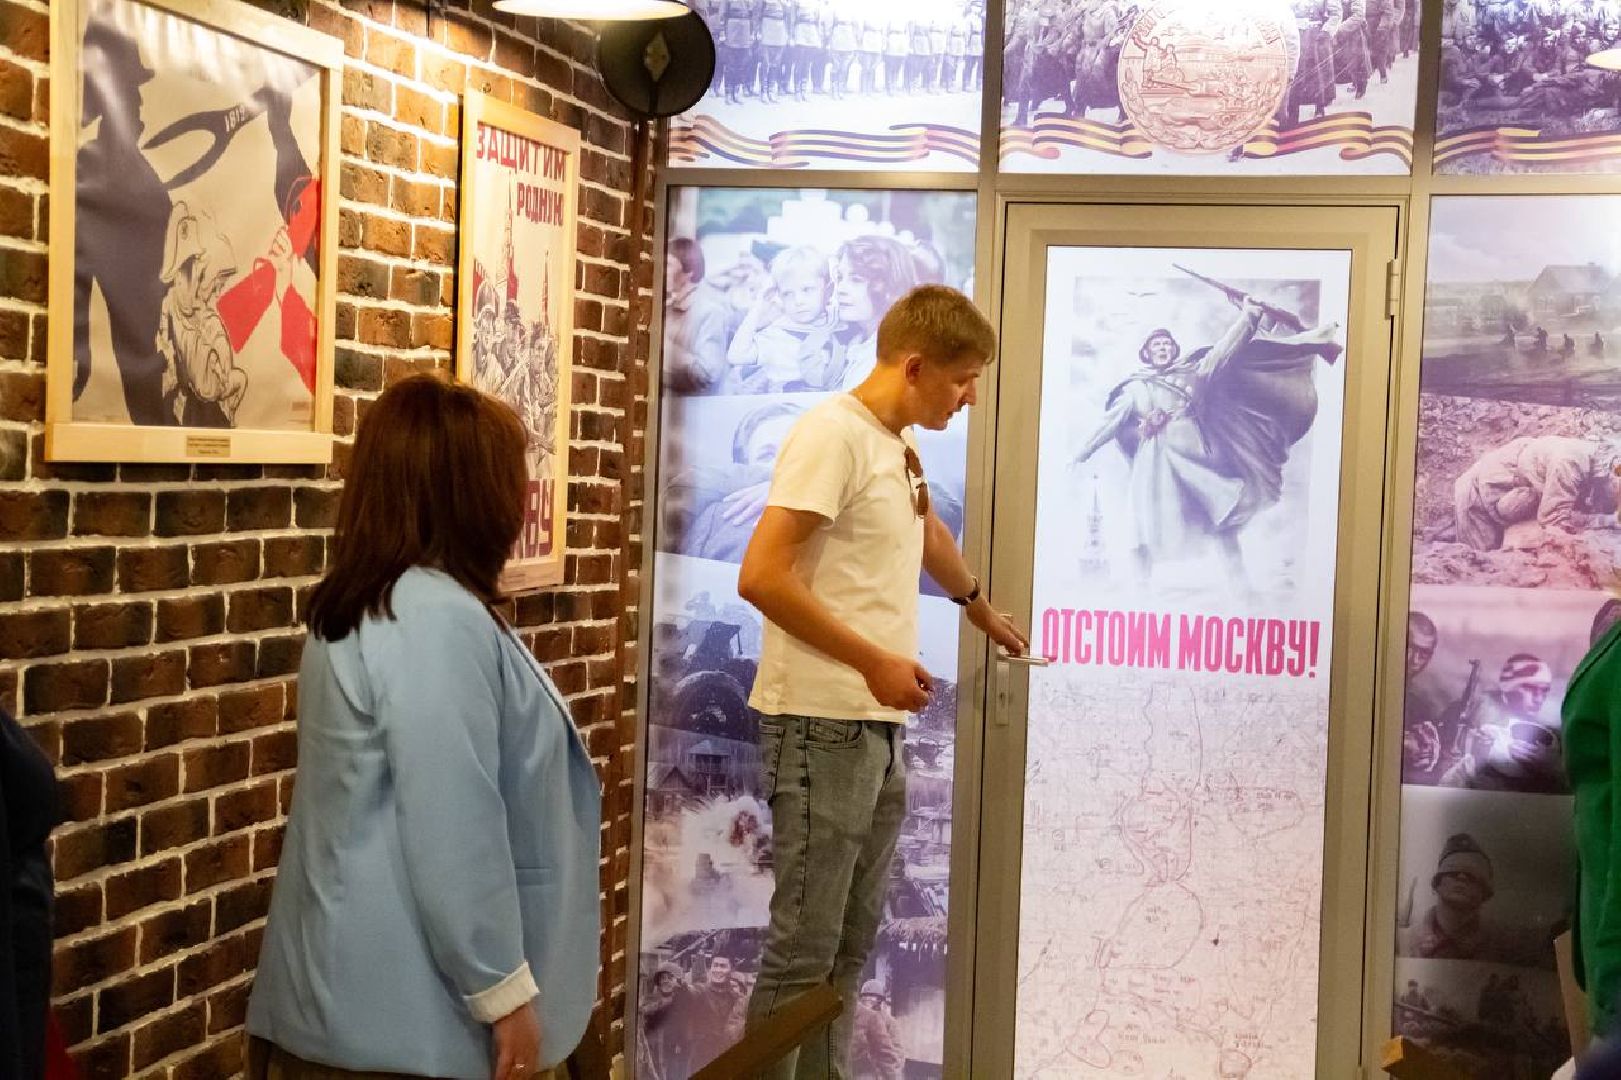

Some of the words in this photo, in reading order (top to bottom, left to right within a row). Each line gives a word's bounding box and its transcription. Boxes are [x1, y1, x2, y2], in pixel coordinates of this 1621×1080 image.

[476, 124, 567, 182] ЗАЩИТИМ
[516, 182, 565, 227] РОДНУЮ
[1042, 608, 1172, 669] ОТСТОИМ
[1178, 614, 1321, 679] МОСКВУ!
